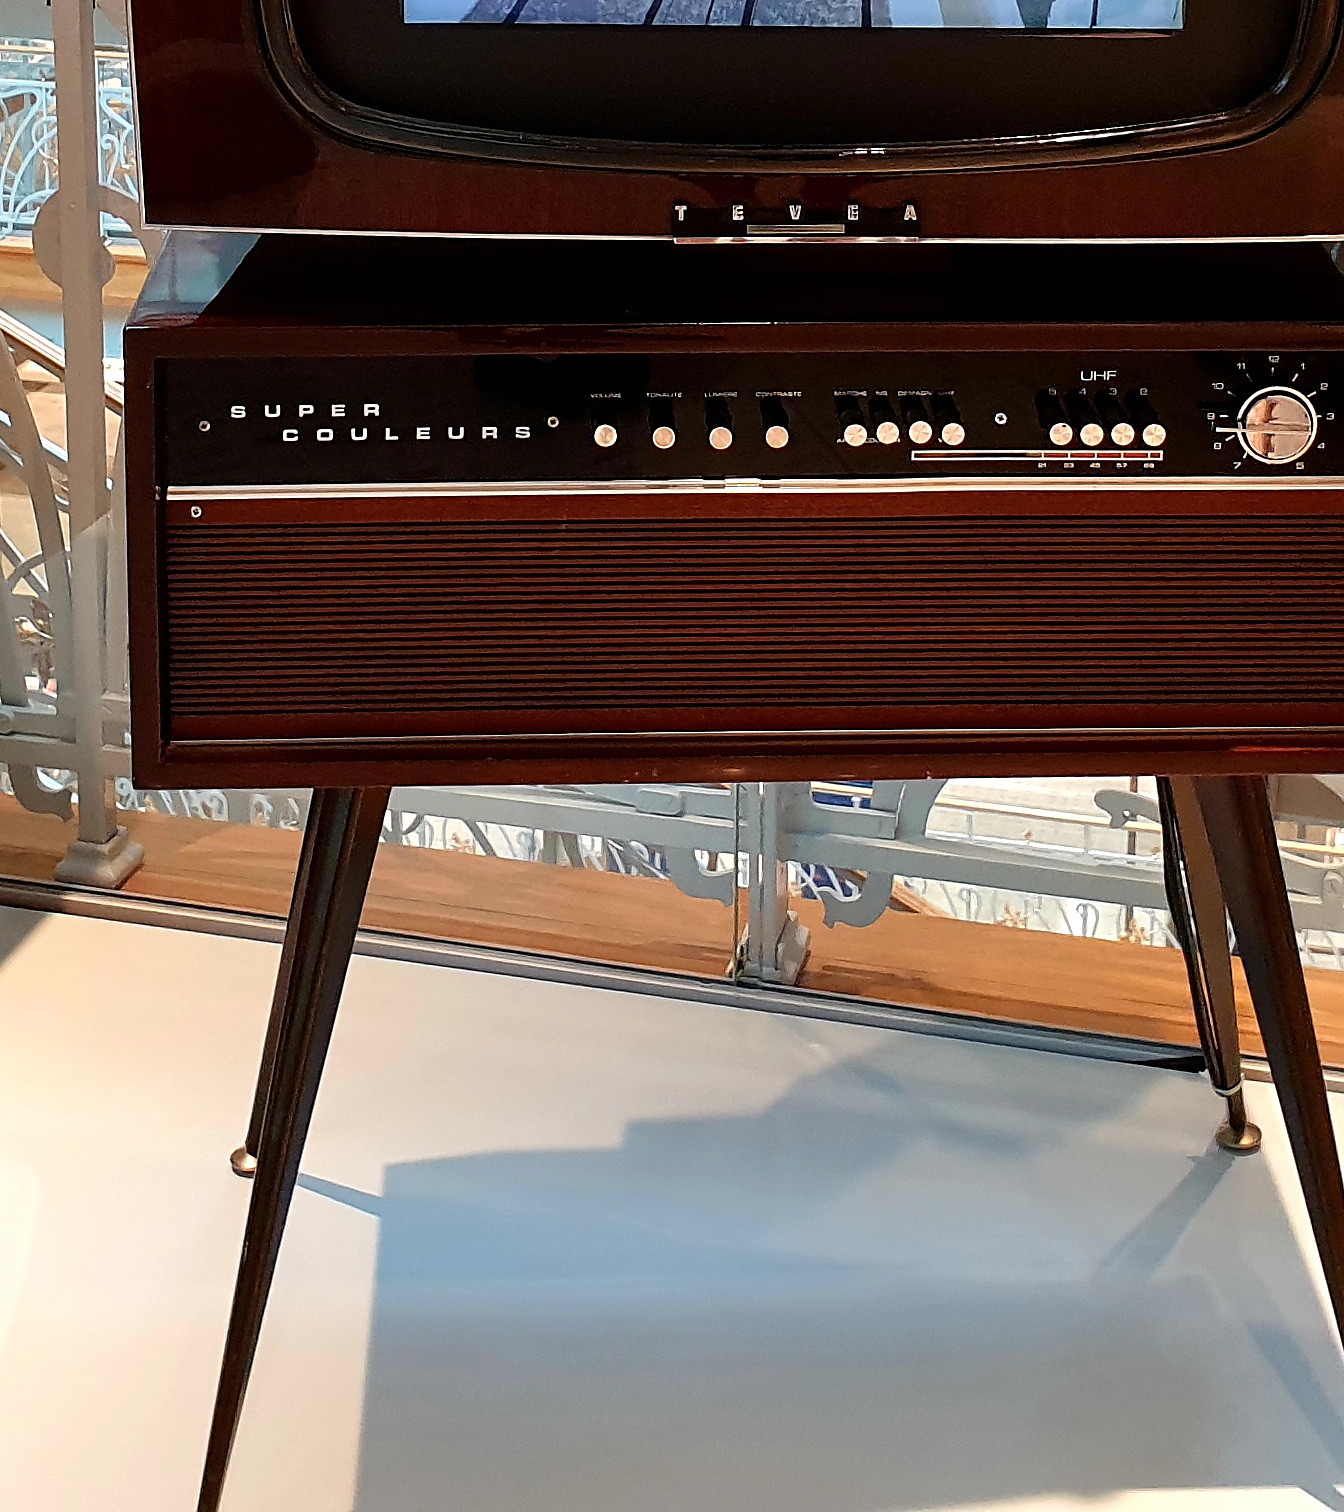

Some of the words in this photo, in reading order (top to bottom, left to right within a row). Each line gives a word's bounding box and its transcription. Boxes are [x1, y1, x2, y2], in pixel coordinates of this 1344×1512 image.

[1080, 370, 1117, 381] UHF
[1320, 382, 1329, 390] 2
[230, 404, 380, 418] SUPER
[1326, 412, 1335, 420] 3
[282, 426, 532, 442] COULEURS
[1317, 442, 1326, 450] 4
[1232, 461, 1242, 470] 7
